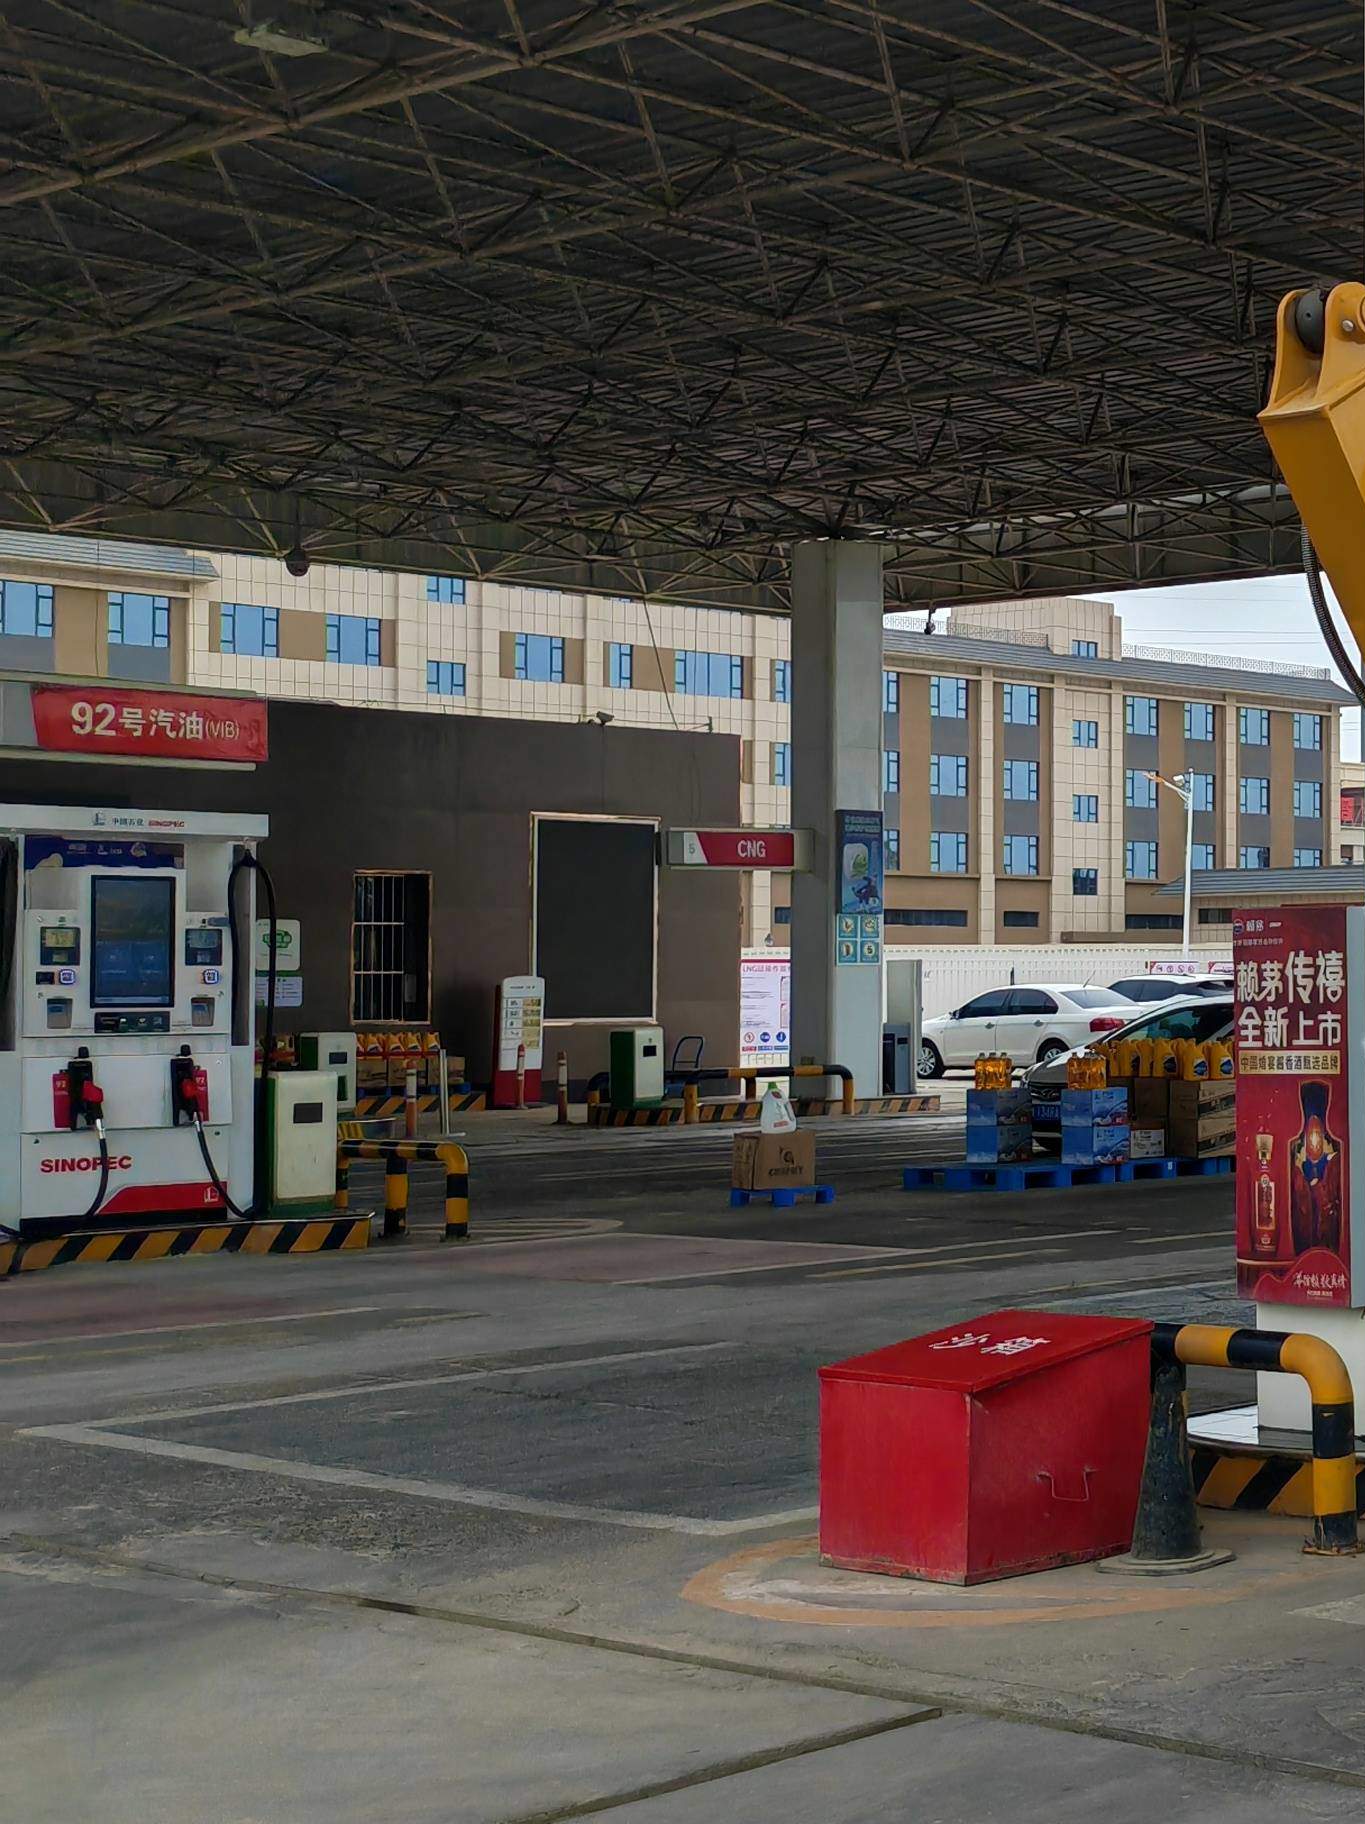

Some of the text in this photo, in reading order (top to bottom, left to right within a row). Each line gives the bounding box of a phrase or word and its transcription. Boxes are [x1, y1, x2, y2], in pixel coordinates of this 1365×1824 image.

[737, 840, 767, 858] CNG
[1236, 950, 1345, 1003] 赖茅传禧
[1238, 1006, 1342, 1048] 全新上市
